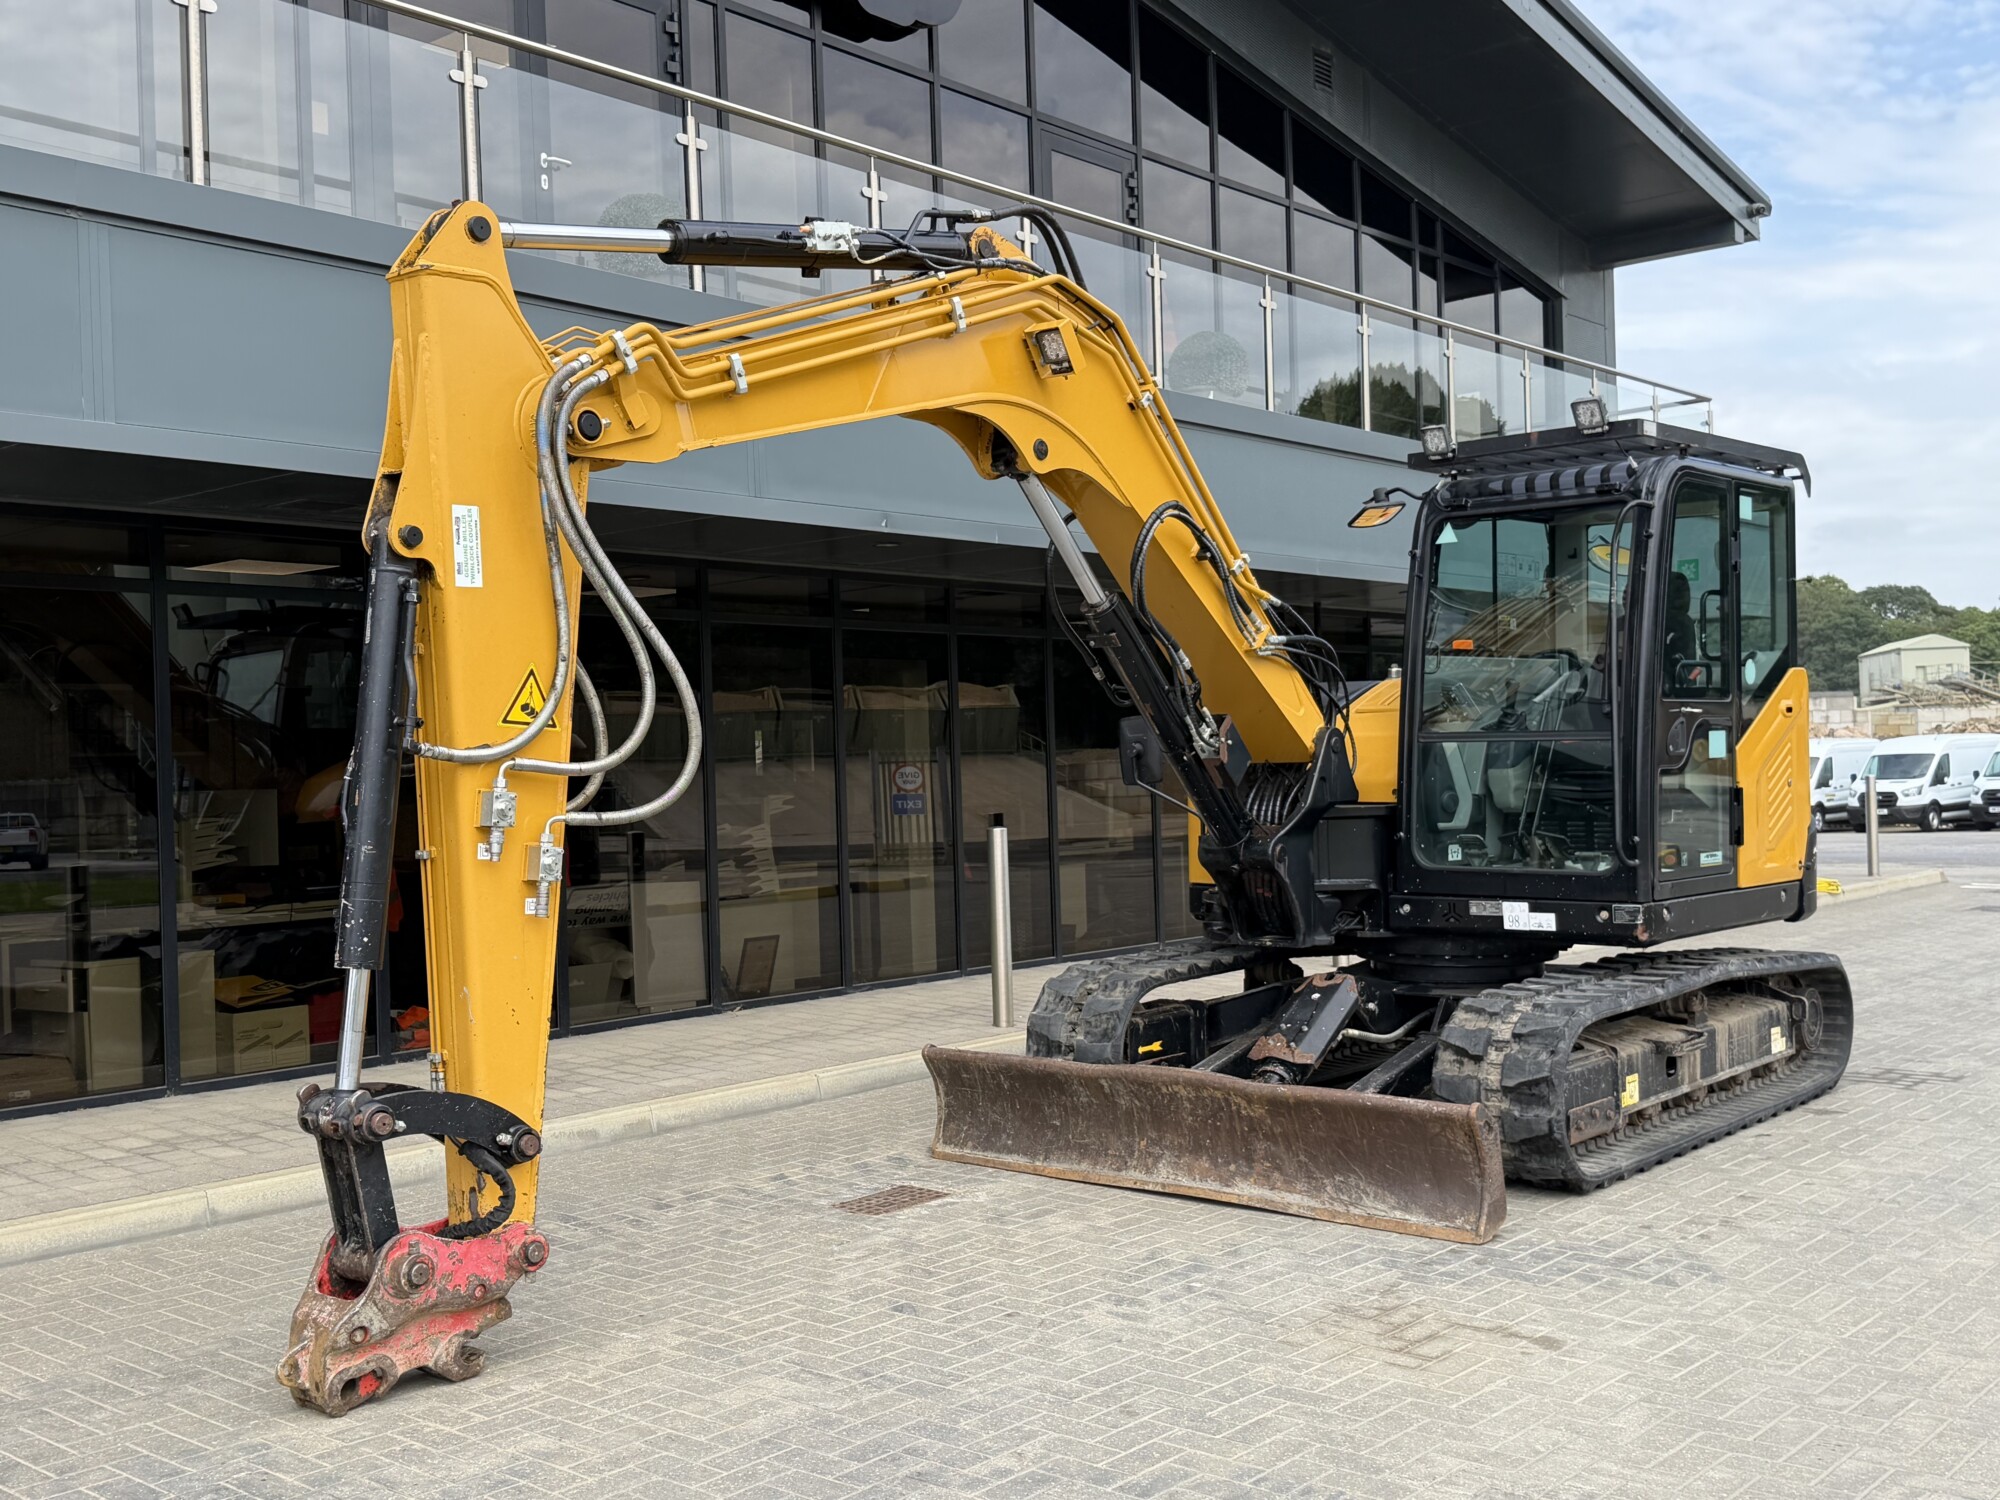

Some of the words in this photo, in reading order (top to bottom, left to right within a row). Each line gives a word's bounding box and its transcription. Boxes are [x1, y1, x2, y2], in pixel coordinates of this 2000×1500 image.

[586, 891, 627, 902] ehicles
[574, 903, 630, 915] ncoming
[581, 916, 605, 925] way
[609, 914, 631, 922] ive
[1508, 914, 1520, 928] 98
